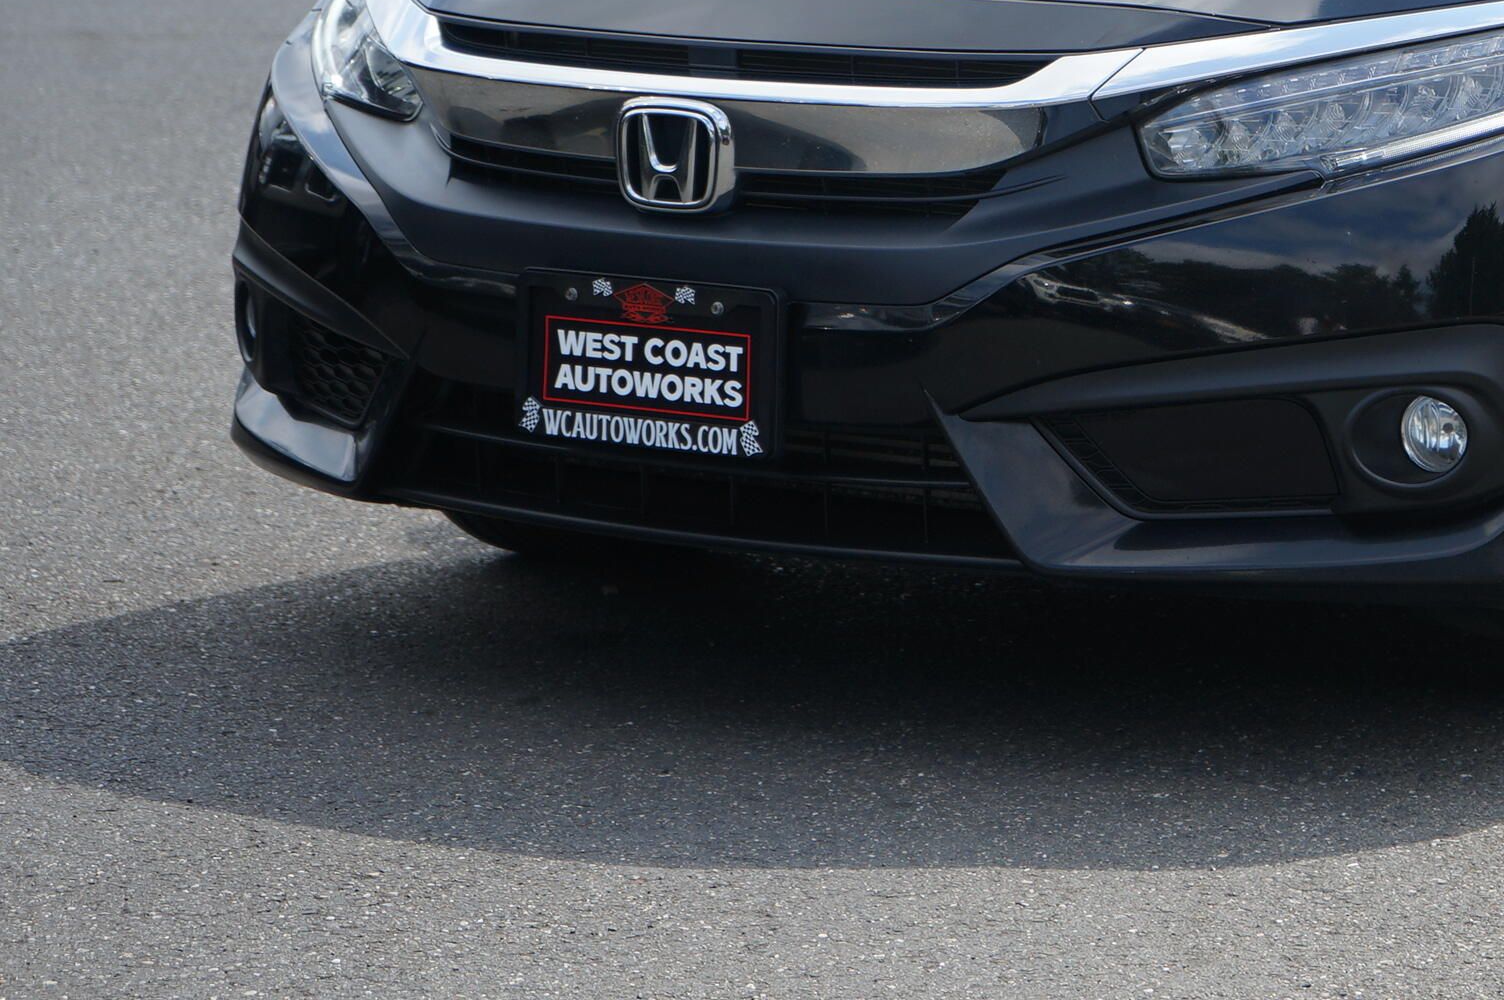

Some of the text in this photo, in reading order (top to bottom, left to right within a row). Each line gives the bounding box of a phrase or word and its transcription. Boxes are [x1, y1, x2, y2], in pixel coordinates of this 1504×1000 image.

[557, 329, 743, 373] WEST COAST
[554, 364, 743, 408] AUTOWORKS
[542, 408, 738, 455] WCAUTOWORKS.COM
